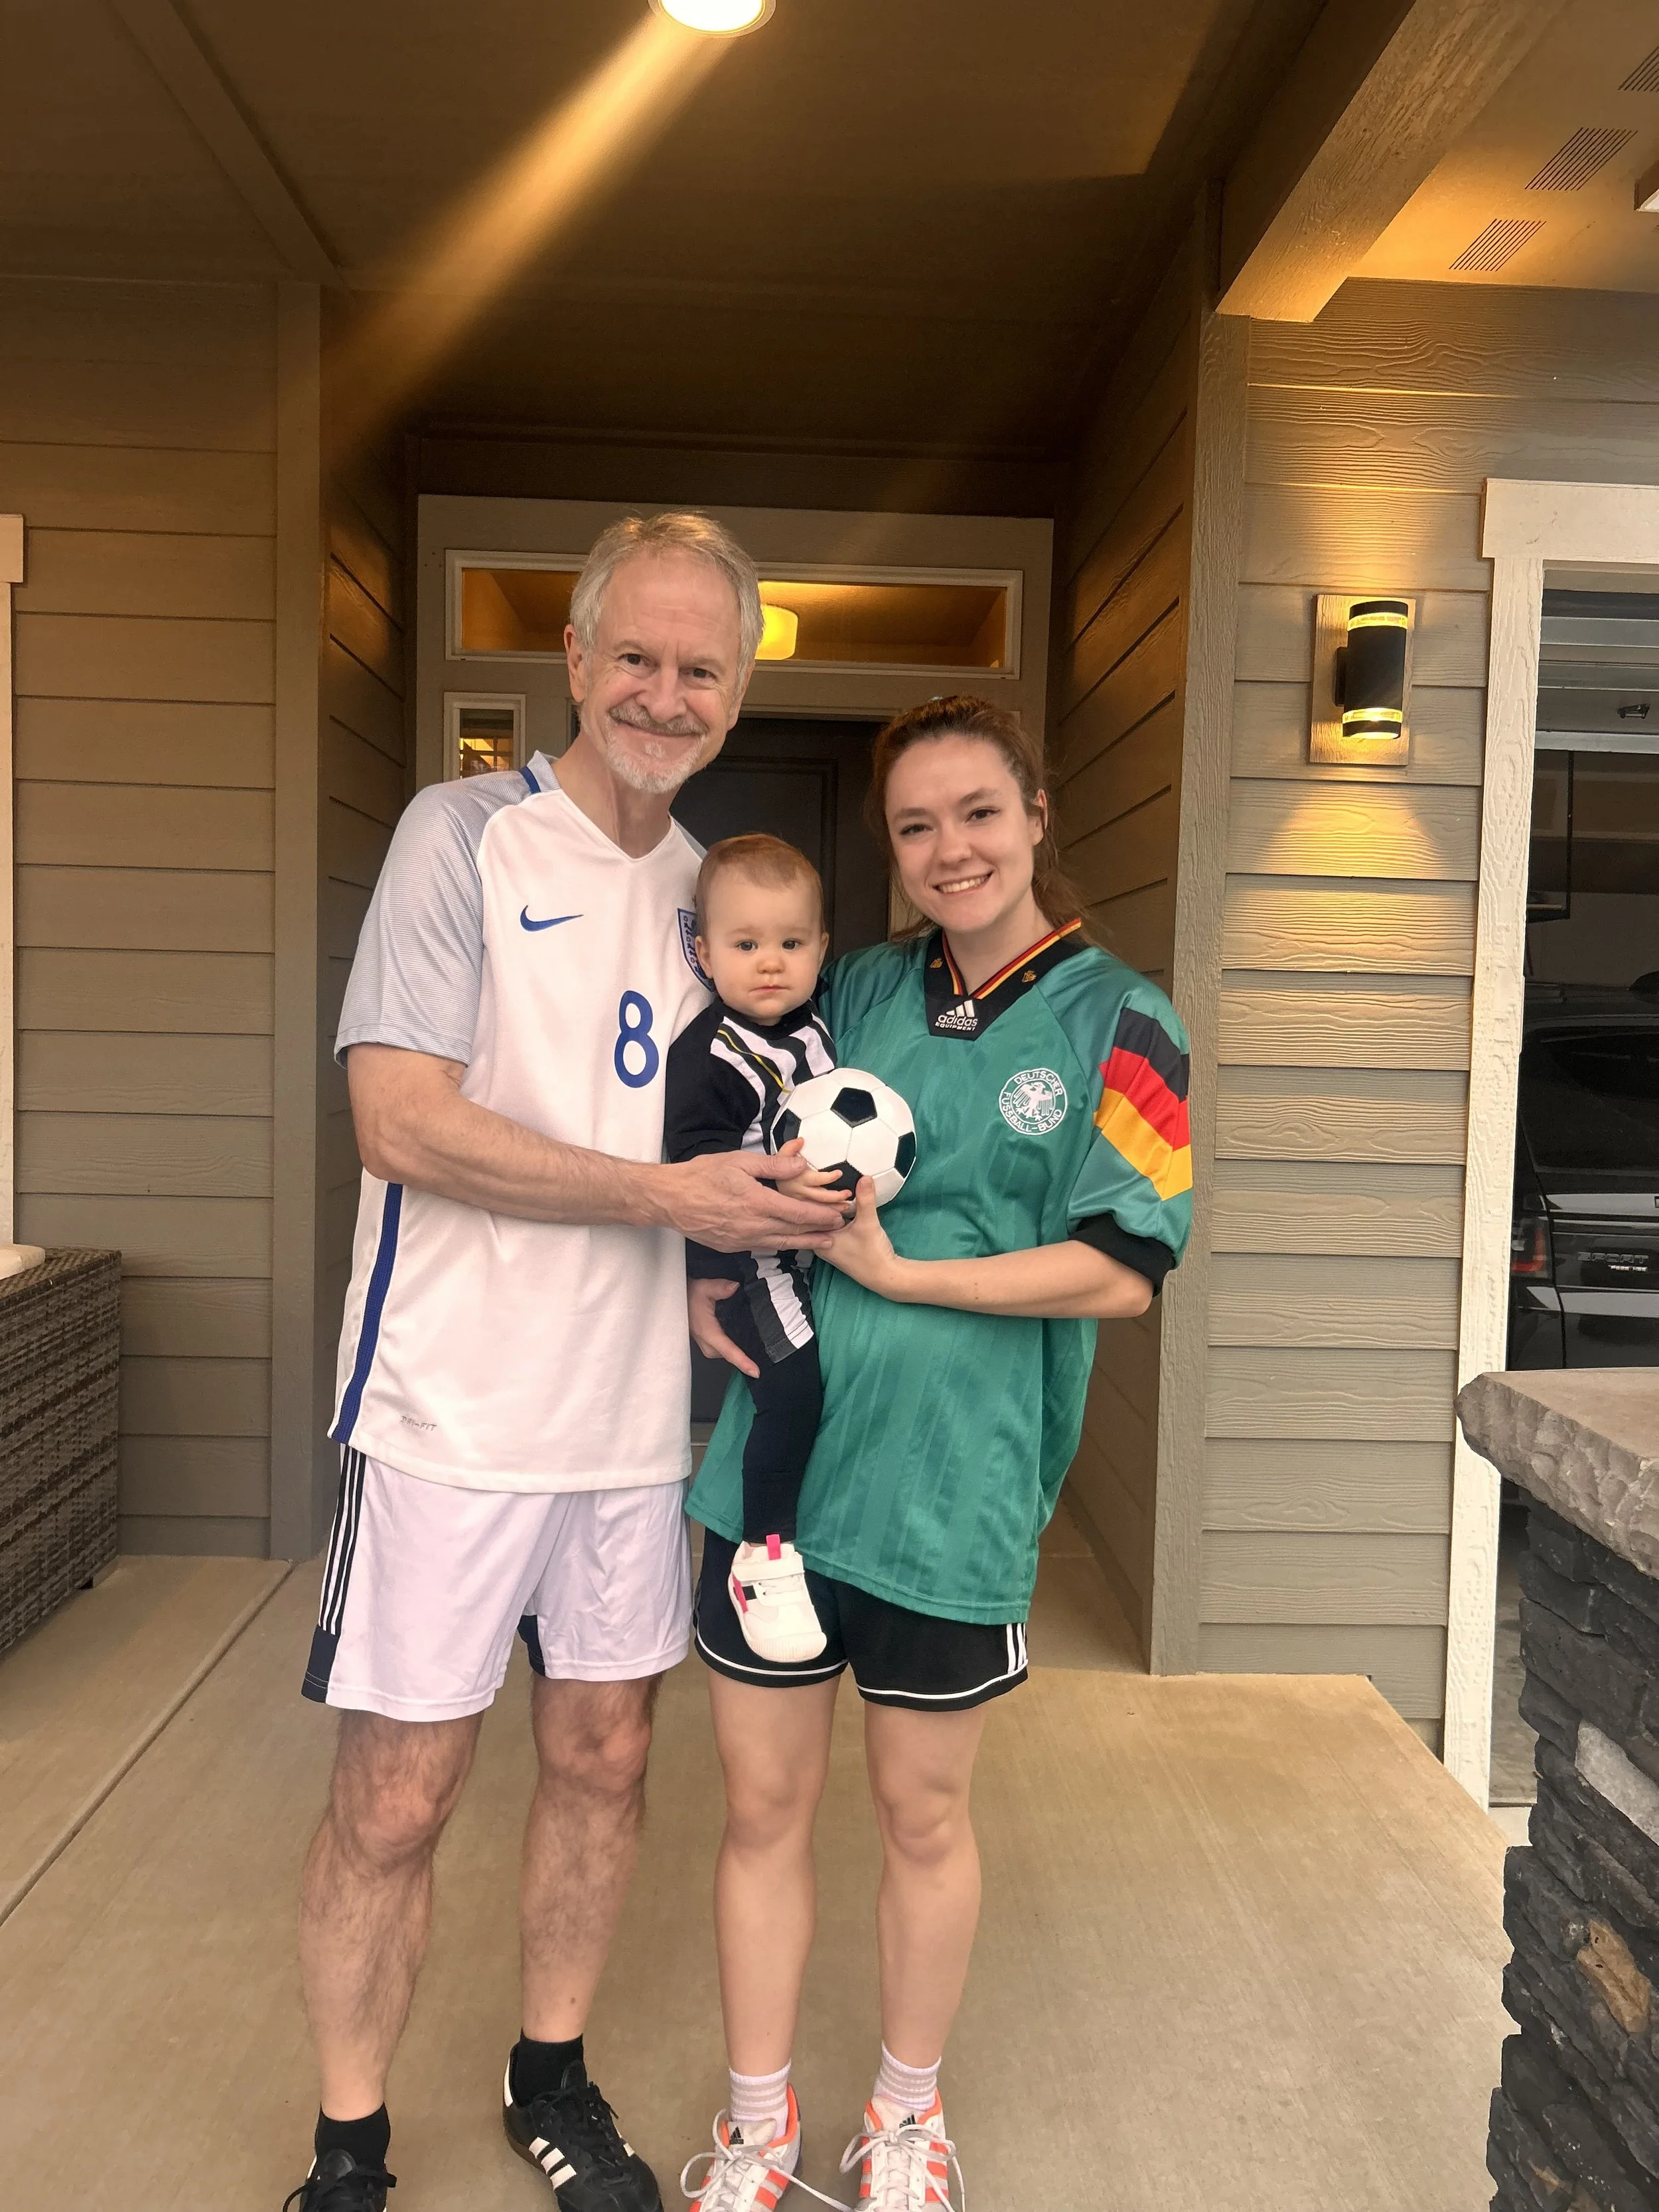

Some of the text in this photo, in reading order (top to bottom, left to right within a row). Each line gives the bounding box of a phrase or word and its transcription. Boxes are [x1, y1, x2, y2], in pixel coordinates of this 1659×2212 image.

[935, 1021, 975, 1031] EQUIPMENT
[938, 1015, 978, 1027] adidas
[614, 990, 659, 1088] 8
[1014, 1070, 1063, 1096] DEUTSCHER
[400, 1415, 437, 1431] DRI-FIT
